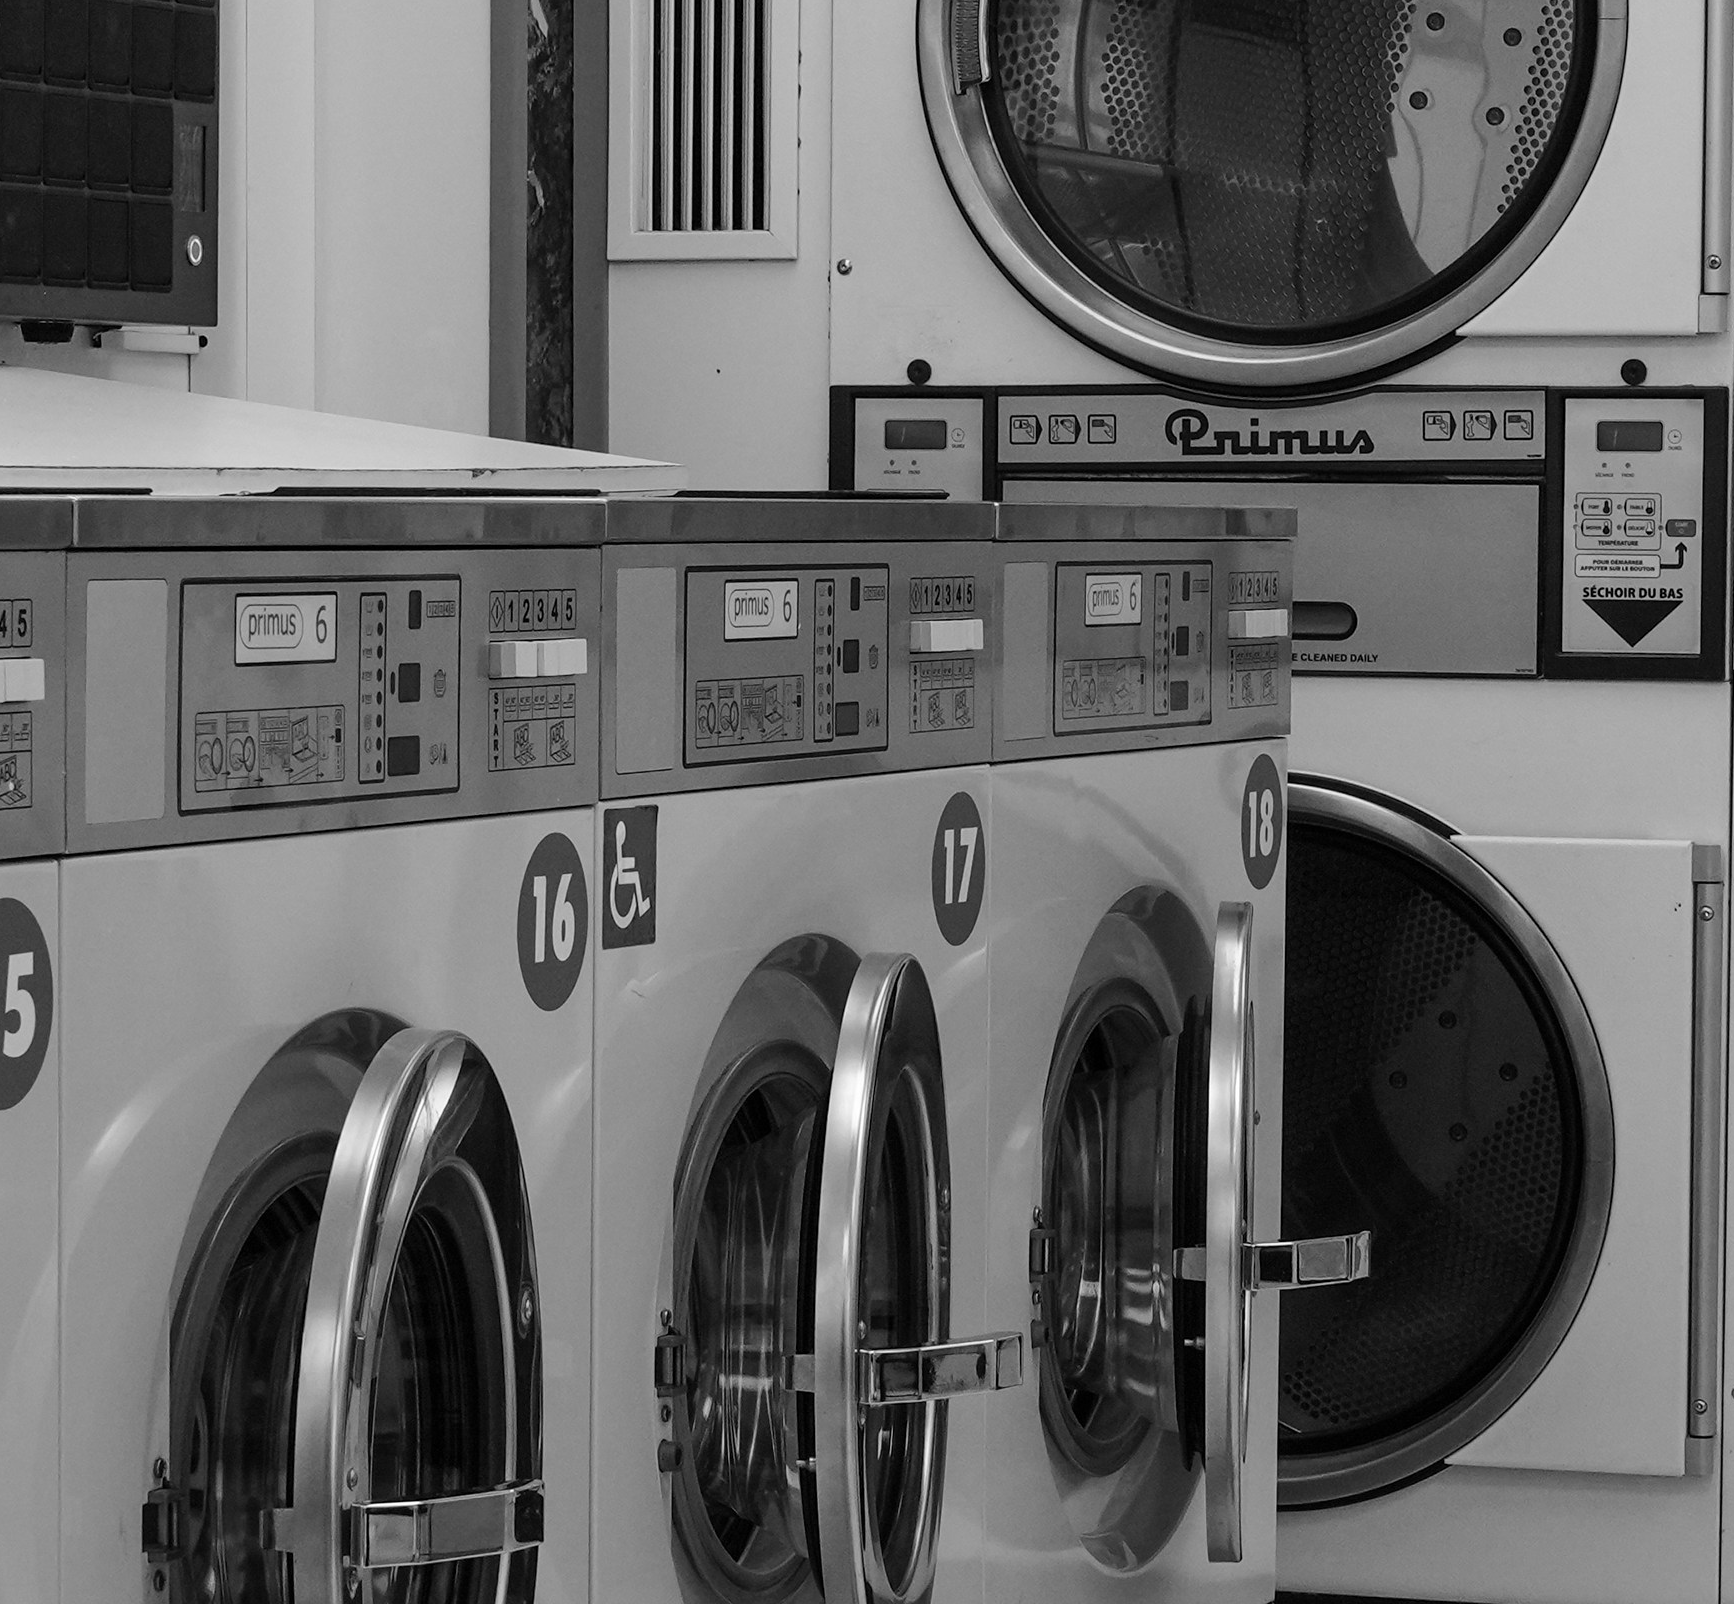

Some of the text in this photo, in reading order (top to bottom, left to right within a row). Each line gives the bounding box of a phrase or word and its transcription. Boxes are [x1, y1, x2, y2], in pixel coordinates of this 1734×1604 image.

[1165, 408, 1375, 456] Primus
[734, 589, 792, 623] primus 6
[1092, 581, 1137, 612] primus 6
[1582, 584, 1683, 599] SÉCHOIR DU BAS
[249, 605, 328, 644] primus 6
[1300, 653, 1348, 662] CLEANED
[1350, 653, 1378, 663] DAILY
[1249, 789, 1274, 858] 18
[944, 826, 979, 905] 17
[533, 873, 576, 964] 16
